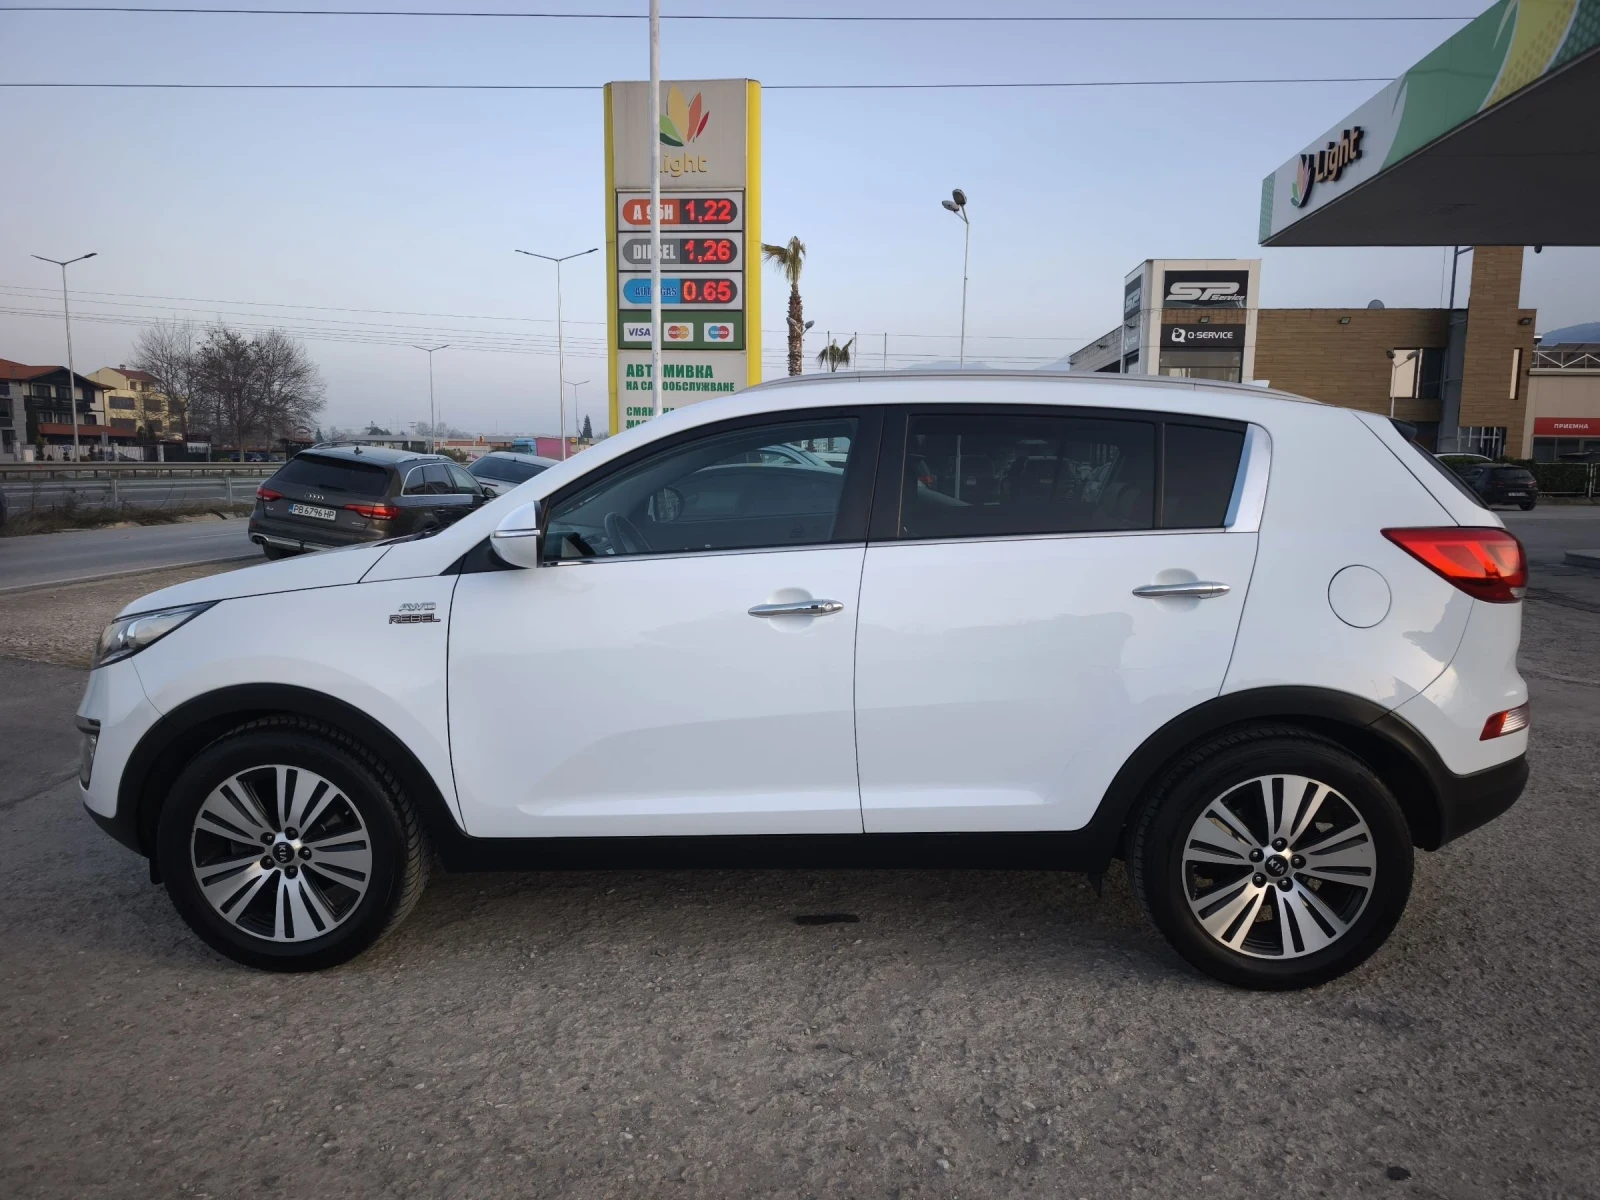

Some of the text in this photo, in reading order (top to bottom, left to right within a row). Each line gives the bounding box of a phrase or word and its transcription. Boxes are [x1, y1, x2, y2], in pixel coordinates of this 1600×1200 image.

[1315, 126, 1364, 182] Light
[659, 153, 707, 178] ight
[633, 204, 643, 220] A
[685, 200, 731, 222] 1,22
[685, 240, 731, 263] 1,26
[634, 286, 677, 297] AUTGAS
[1165, 282, 1240, 300] SP
[628, 327, 651, 337] VISA
[626, 364, 714, 378] АВТМИВКА
[626, 381, 735, 392] НА САООБСЛУЖВАНЕ
[304, 507, 323, 517] 6796
[398, 602, 436, 612] AWD
[389, 613, 441, 624] REBEL
[278, 844, 287, 862] KIA
[1268, 858, 1285, 875] KIA
